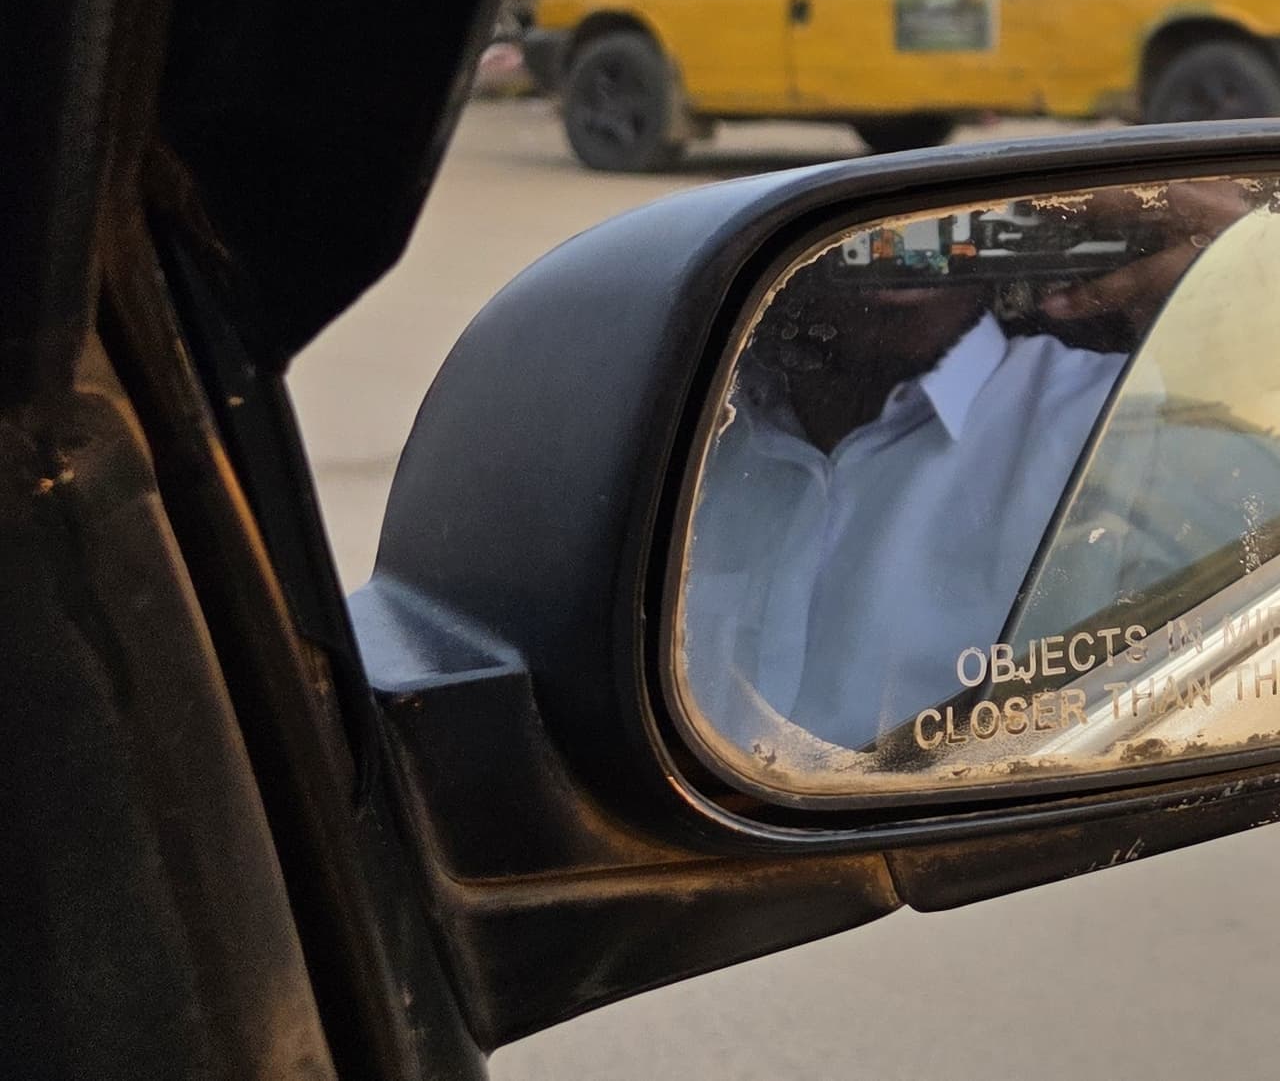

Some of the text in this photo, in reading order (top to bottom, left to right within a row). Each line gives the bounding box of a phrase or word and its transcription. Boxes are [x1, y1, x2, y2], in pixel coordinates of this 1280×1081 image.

[957, 625, 1148, 687] OBJECTS
[1167, 616, 1204, 657] IN
[914, 688, 1089, 750] CLOSER
[1103, 671, 1212, 720] THAN
